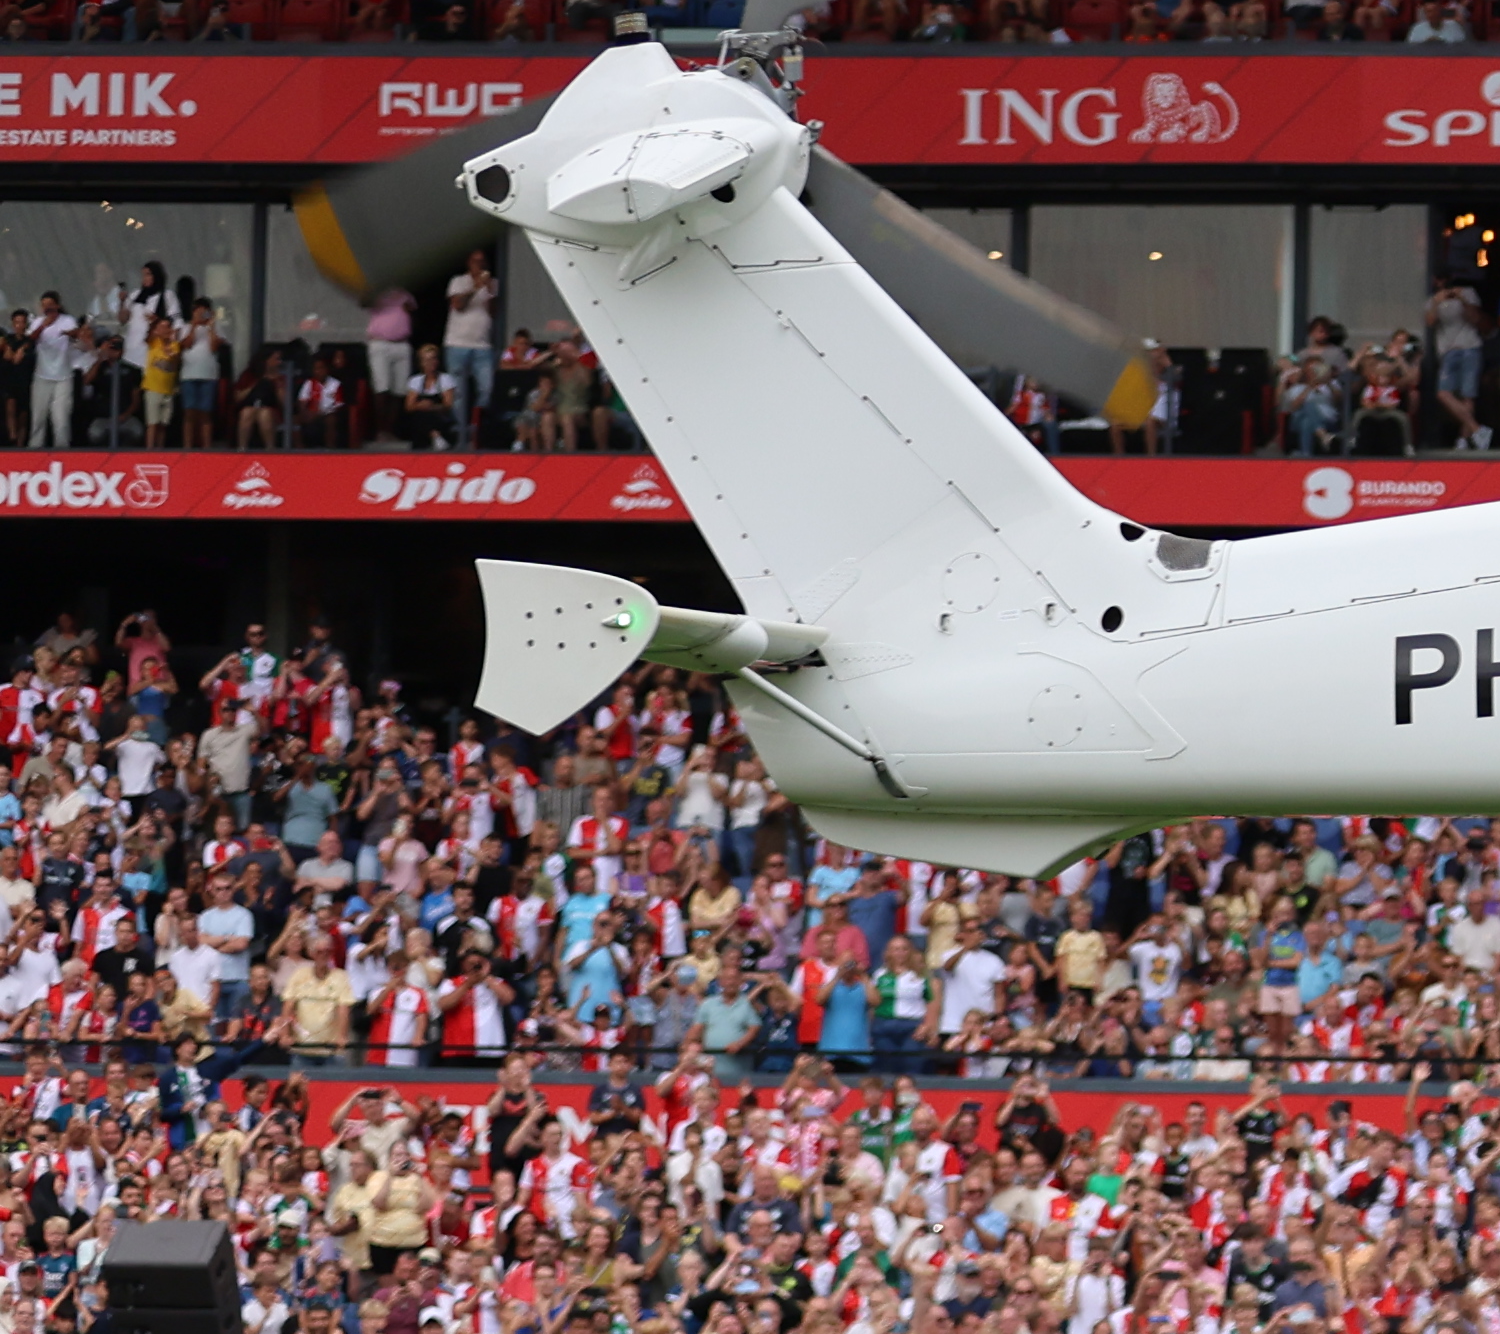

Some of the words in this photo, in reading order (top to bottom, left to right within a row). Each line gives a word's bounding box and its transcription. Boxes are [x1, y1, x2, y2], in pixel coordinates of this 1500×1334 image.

[51, 72, 197, 117] MIK.
[379, 82, 523, 116] RWG
[958, 87, 1122, 145] ING
[0, 128, 67, 146] ESTATE
[70, 128, 176, 146] PARTNERS
[358, 462, 536, 511] Spido
[1359, 480, 1446, 496] BURANDO
